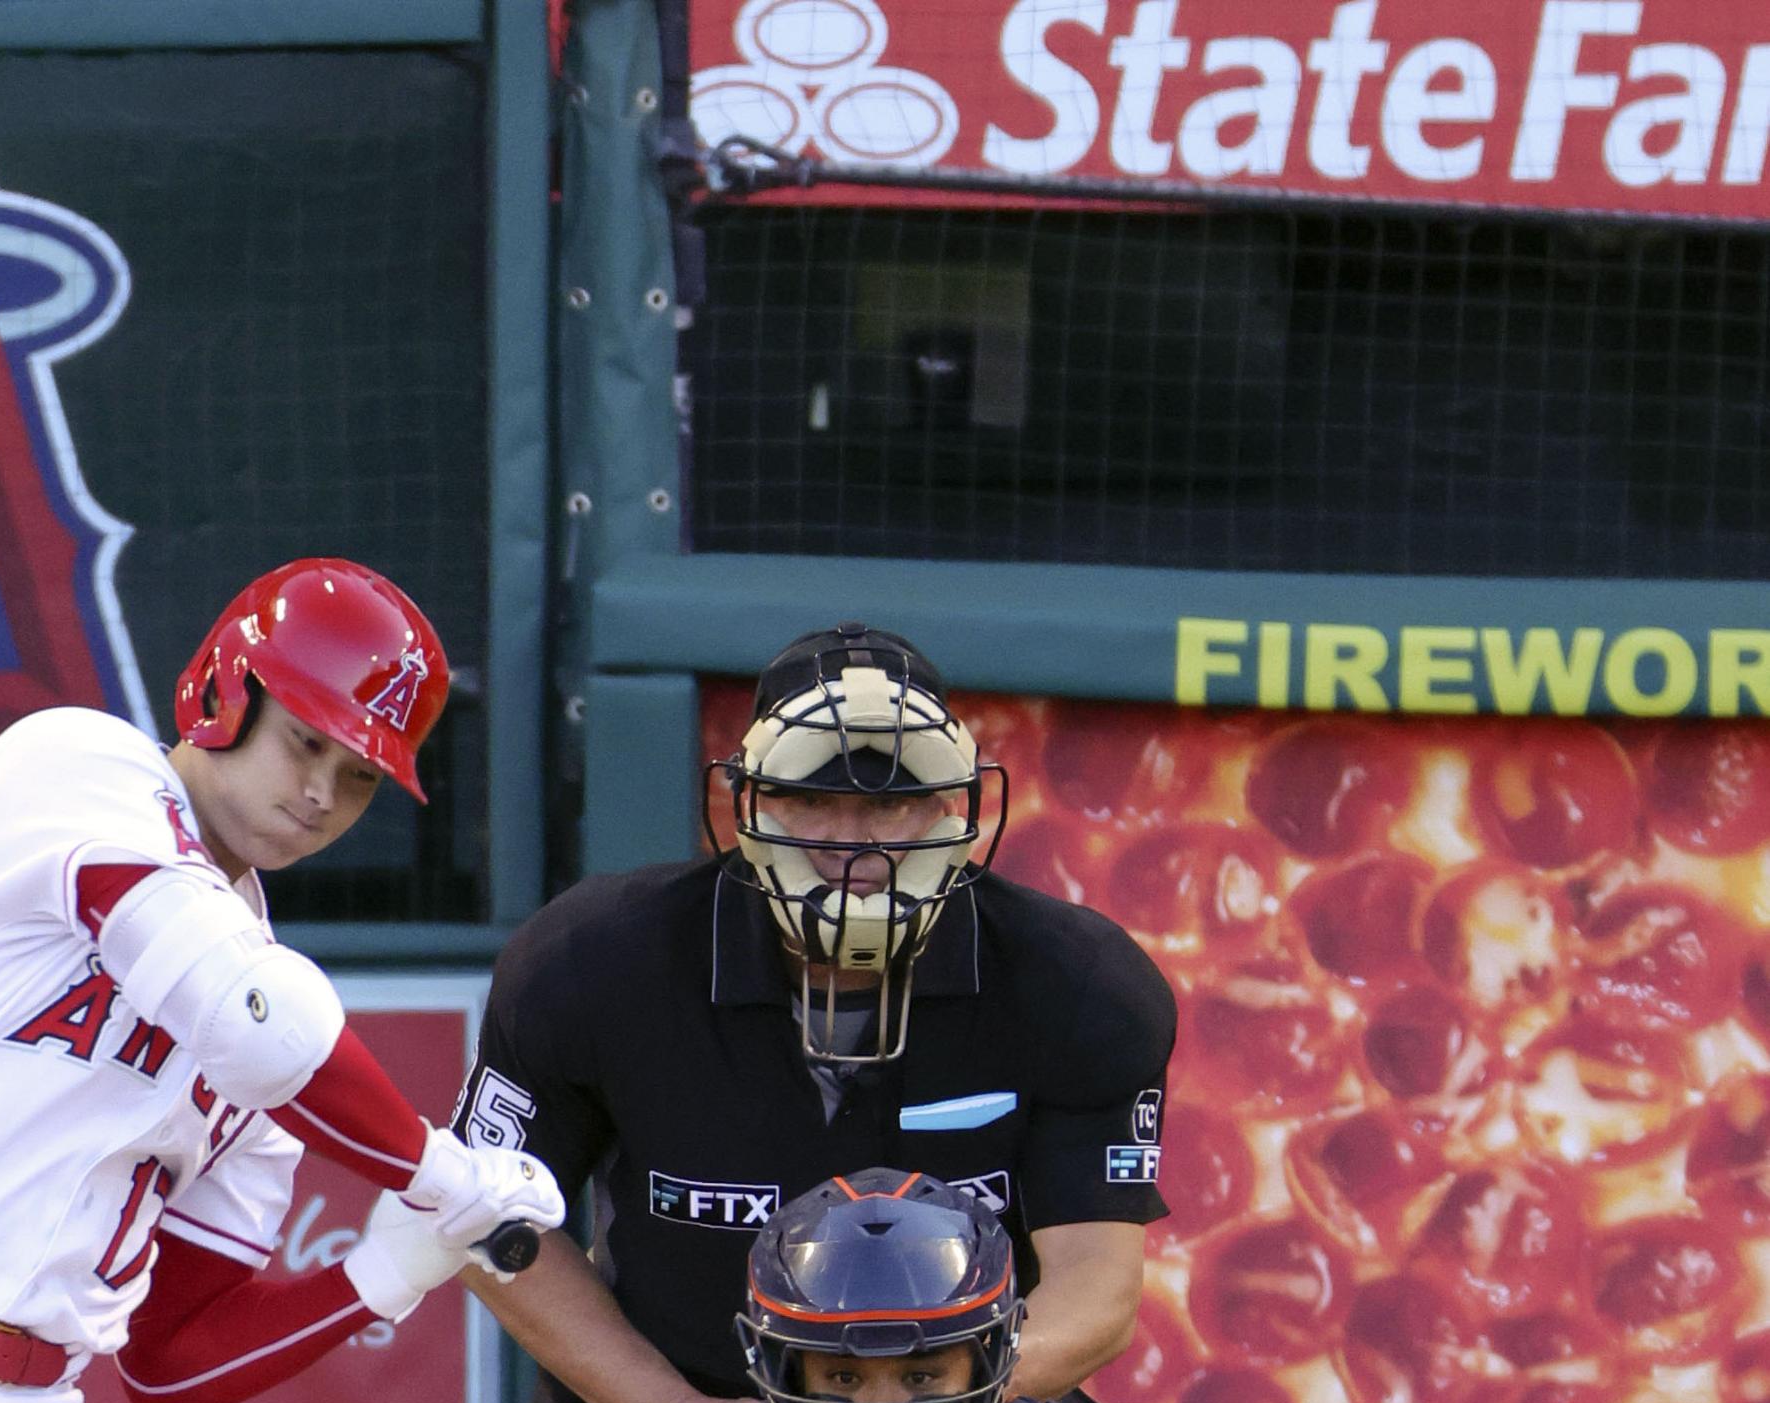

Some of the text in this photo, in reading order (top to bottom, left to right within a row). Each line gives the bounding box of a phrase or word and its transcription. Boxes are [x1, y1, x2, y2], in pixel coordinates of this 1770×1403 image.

[982, 0, 1498, 180] State
[1137, 1103, 1156, 1128] TC
[689, 1190, 774, 1224] FTX
